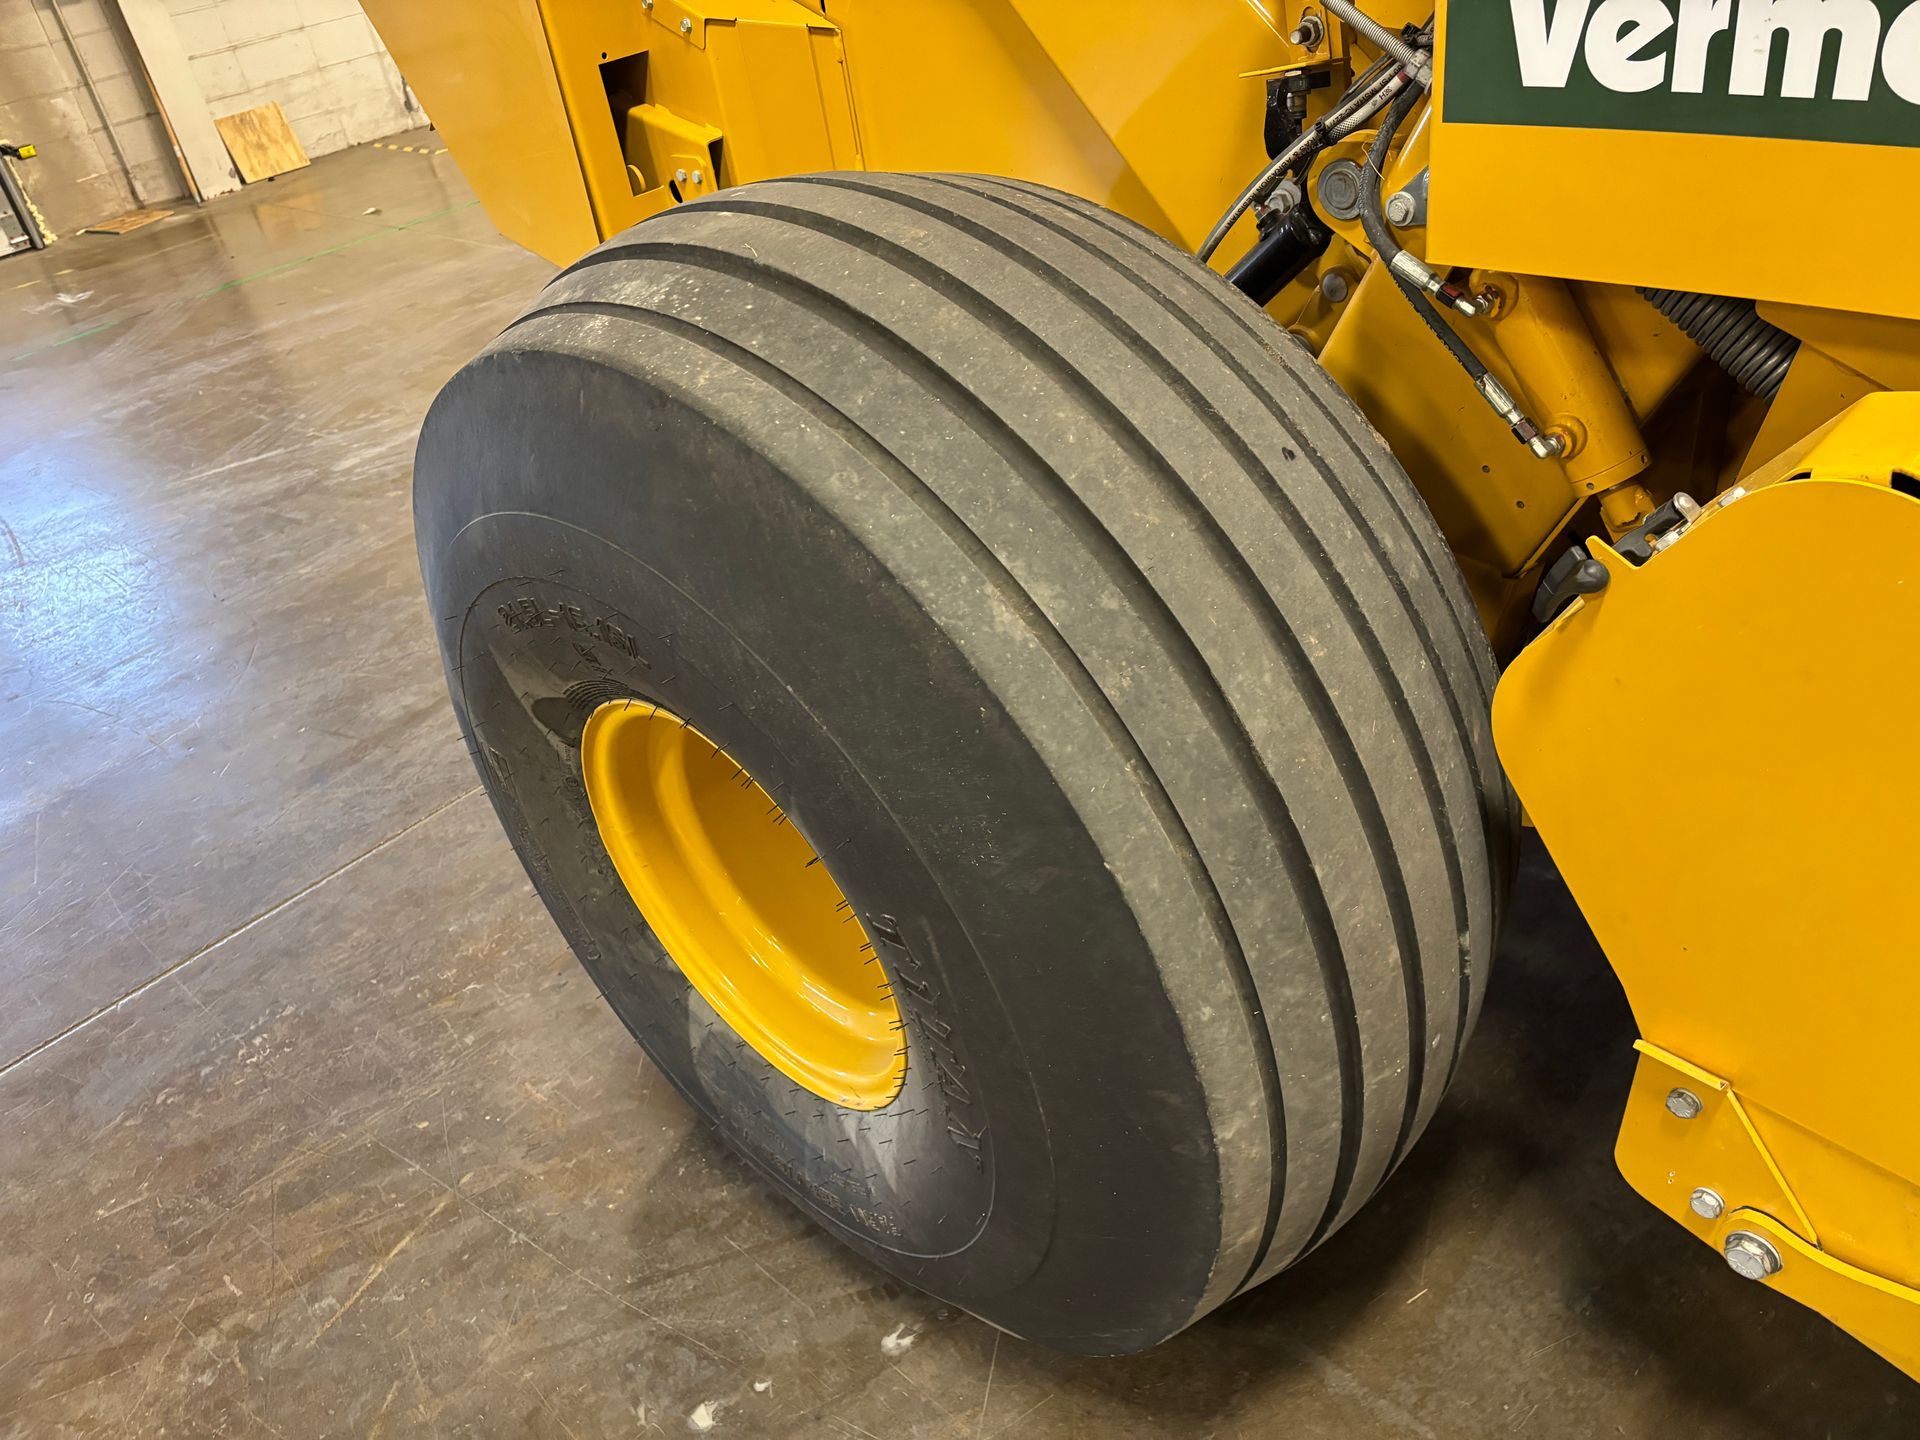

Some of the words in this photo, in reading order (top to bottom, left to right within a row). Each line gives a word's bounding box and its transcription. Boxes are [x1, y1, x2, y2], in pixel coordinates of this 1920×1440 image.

[1378, 73, 1394, 87] PSI
[1352, 86, 1378, 108] MSHA
[1255, 154, 1292, 195] ABRASION
[1223, 192, 1257, 231] RESISTANT
